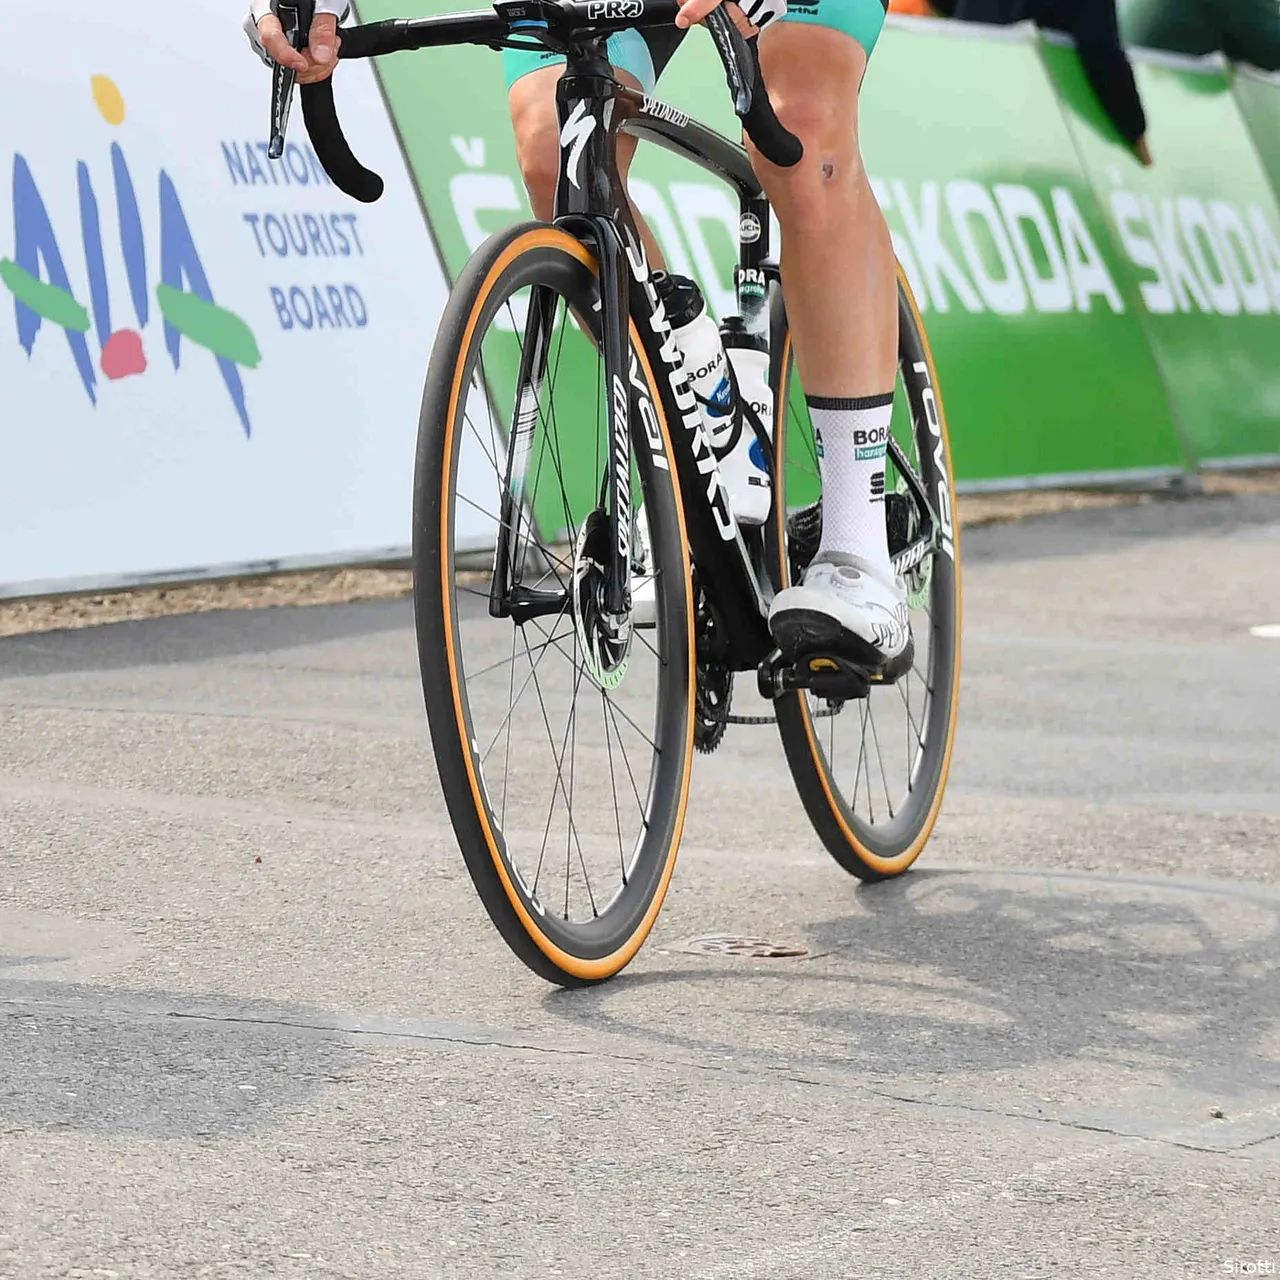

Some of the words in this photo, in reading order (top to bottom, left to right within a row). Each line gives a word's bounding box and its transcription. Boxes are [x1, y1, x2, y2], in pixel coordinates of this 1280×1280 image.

[638, 94, 690, 129] SPECIALIZED
[242, 211, 366, 261] TOURIST
[270, 284, 371, 333] BOARD
[612, 373, 632, 558] SPECIALIZED
